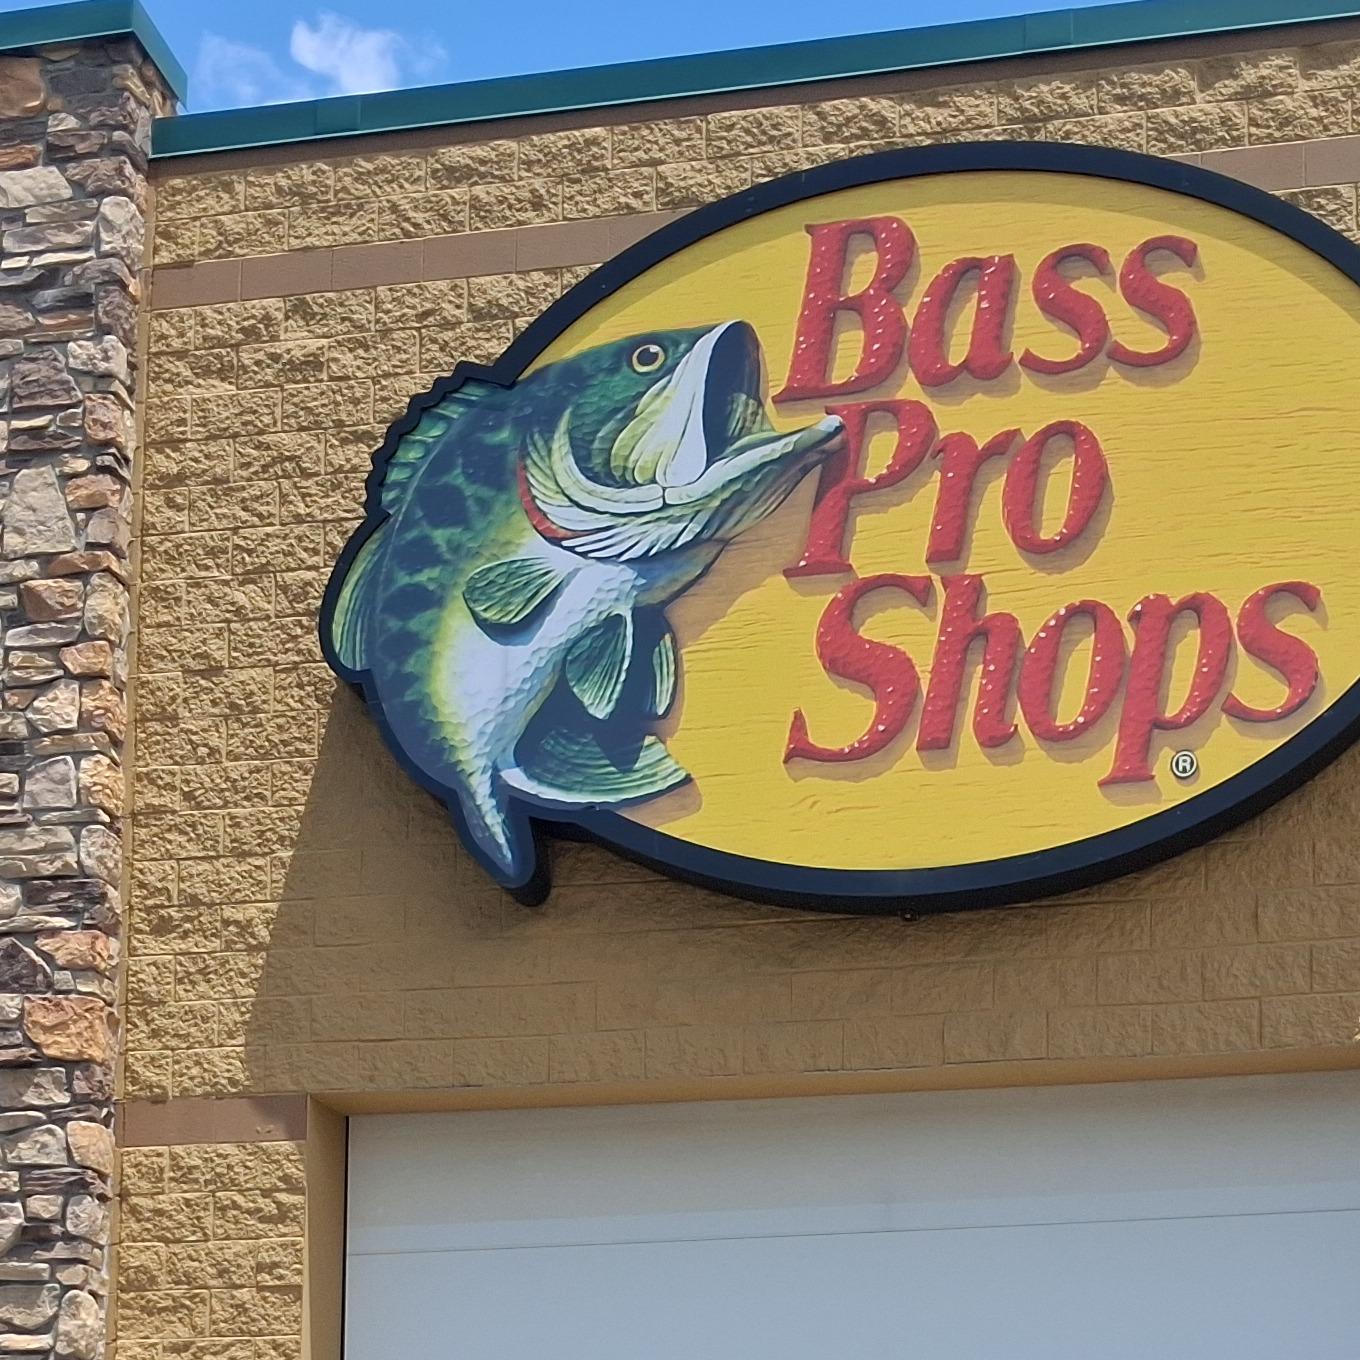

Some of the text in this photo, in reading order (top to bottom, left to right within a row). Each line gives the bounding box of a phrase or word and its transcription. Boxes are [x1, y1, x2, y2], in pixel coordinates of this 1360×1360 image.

[775, 215, 1199, 402] Bass
[784, 399, 1109, 575] Pro
[784, 572, 1322, 788] Shops
